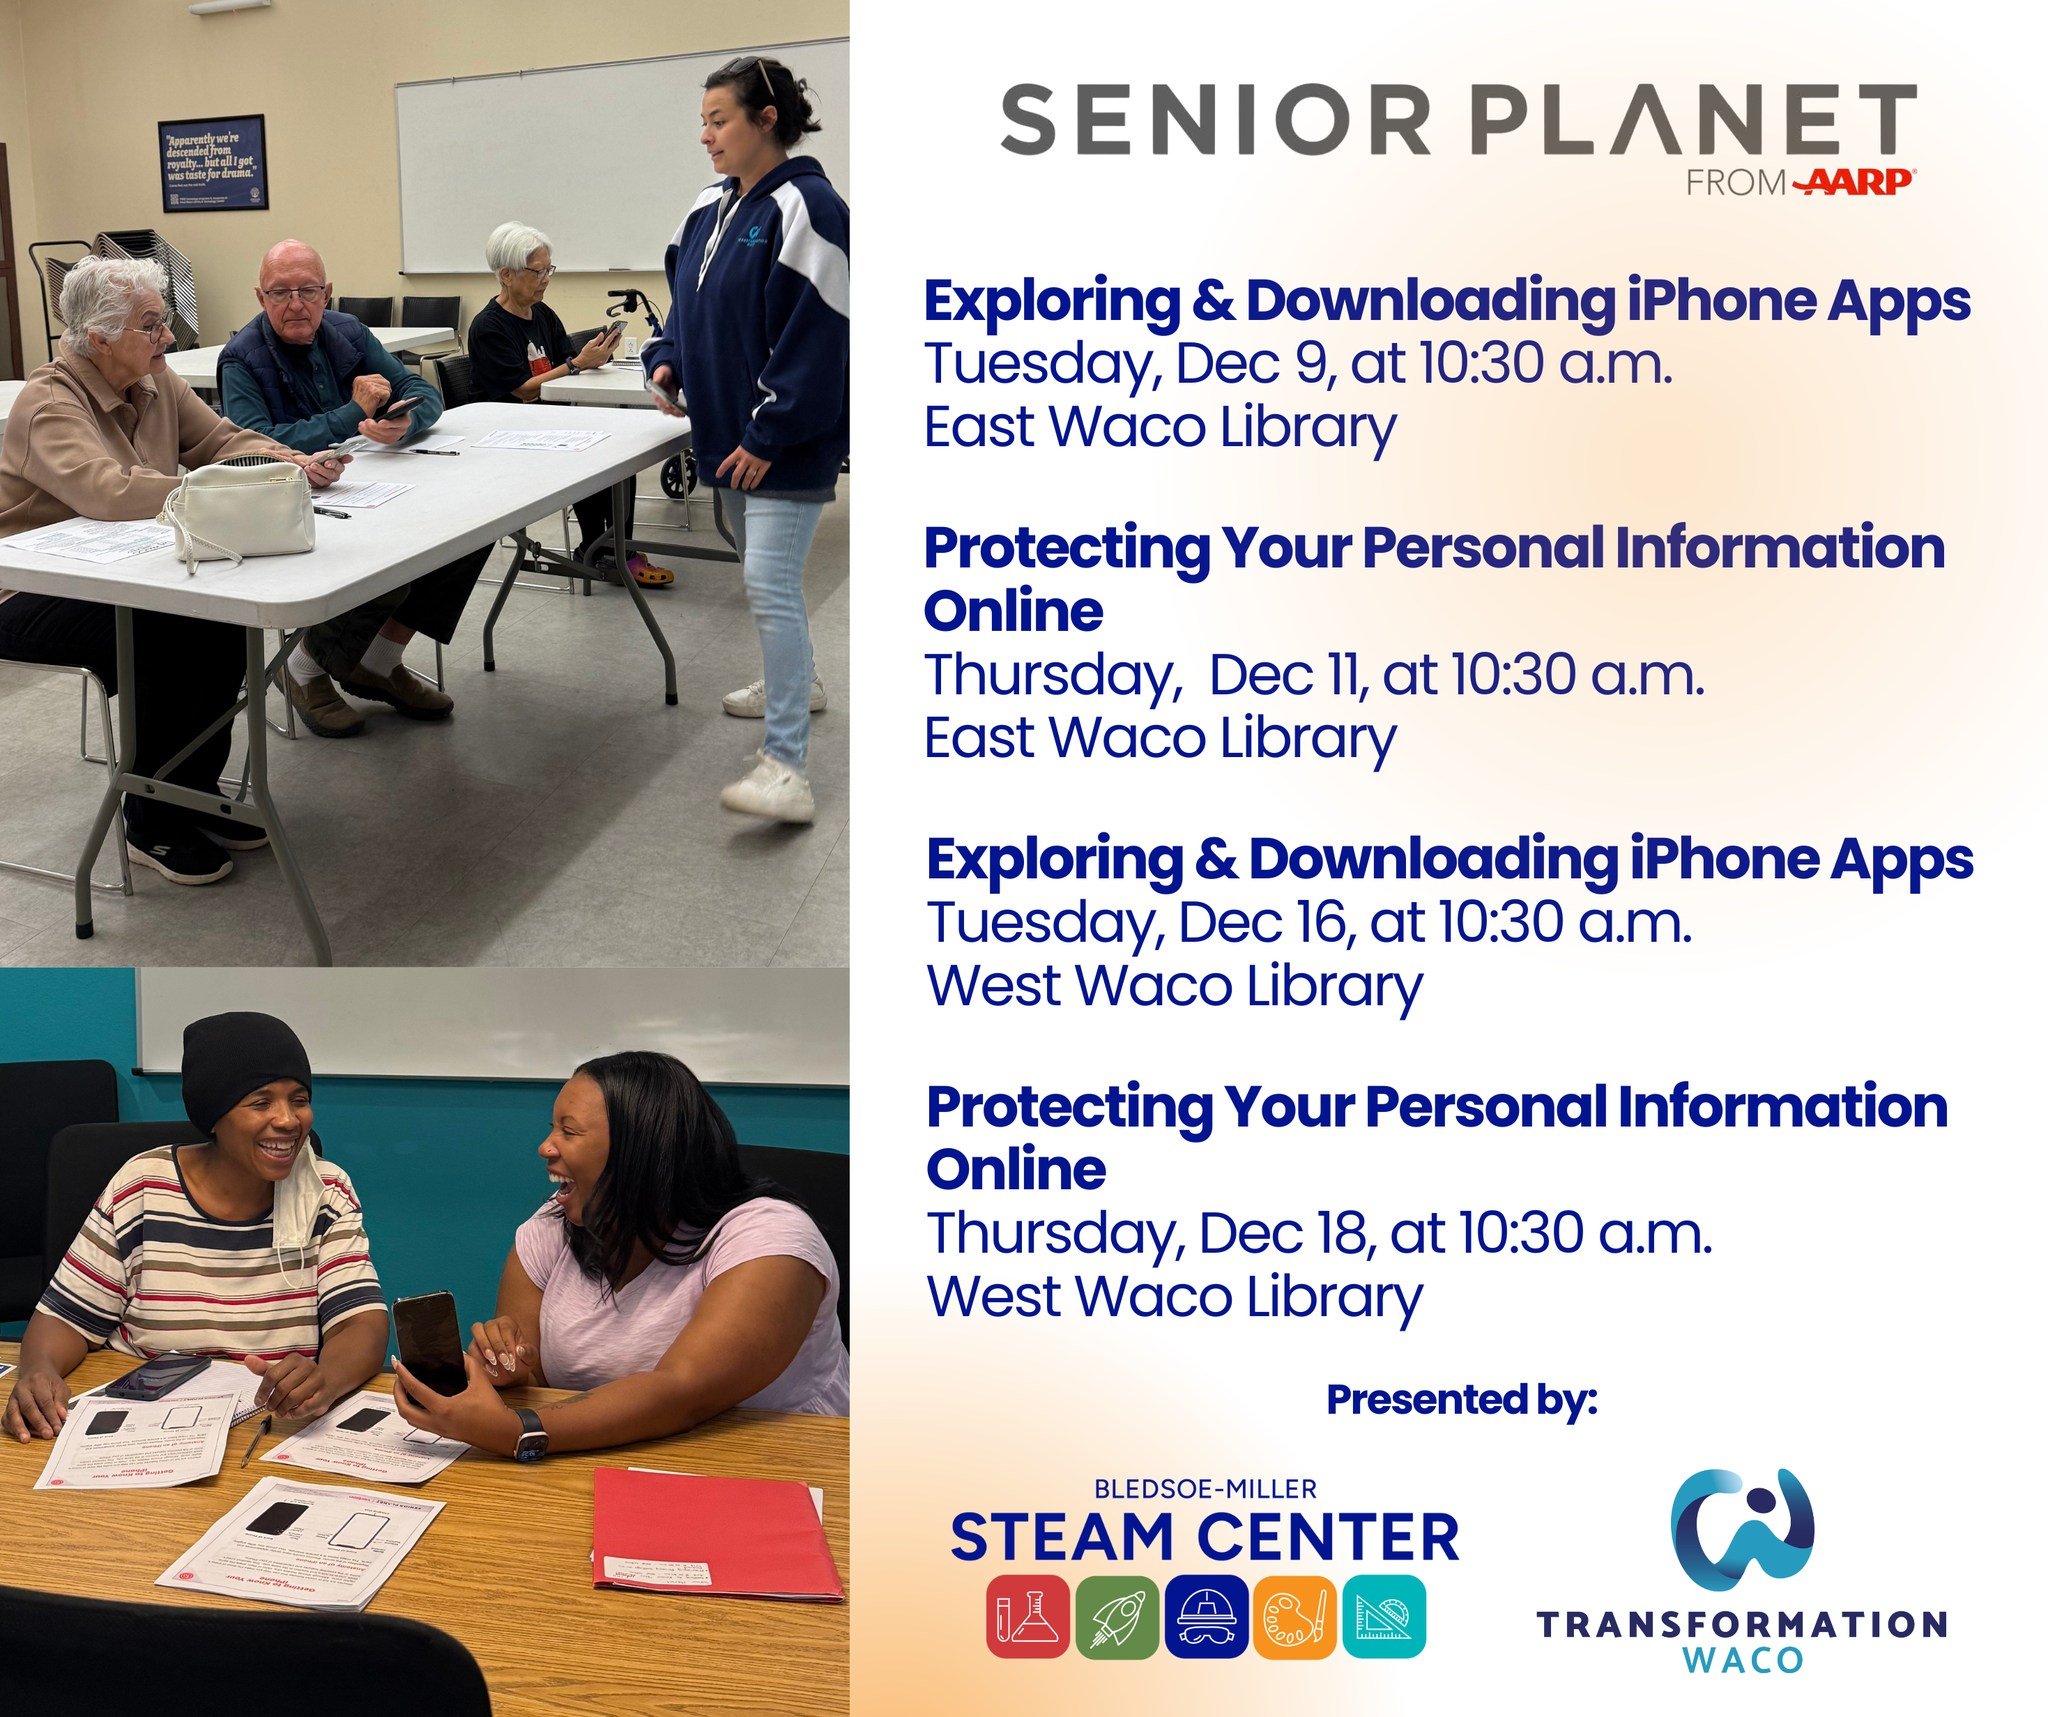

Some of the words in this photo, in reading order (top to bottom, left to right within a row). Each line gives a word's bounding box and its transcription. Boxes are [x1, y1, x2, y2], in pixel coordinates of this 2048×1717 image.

[166, 133, 215, 148] "Apparently
[217, 131, 239, 142] we're
[166, 144, 208, 158] descended
[208, 144, 232, 158] from
[167, 158, 203, 172] royalty...
[204, 157, 220, 167] but
[220, 156, 232, 166] all
[234, 156, 238, 166] I
[238, 156, 254, 169] got
[168, 172, 184, 180] was
[186, 170, 206, 180] taste
[206, 168, 220, 182] for
[222, 165, 258, 178] drama."
[226, 1574, 244, 1582] Your
[259, 1576, 288, 1584] iPhone
[283, 1582, 316, 1593] Getting
